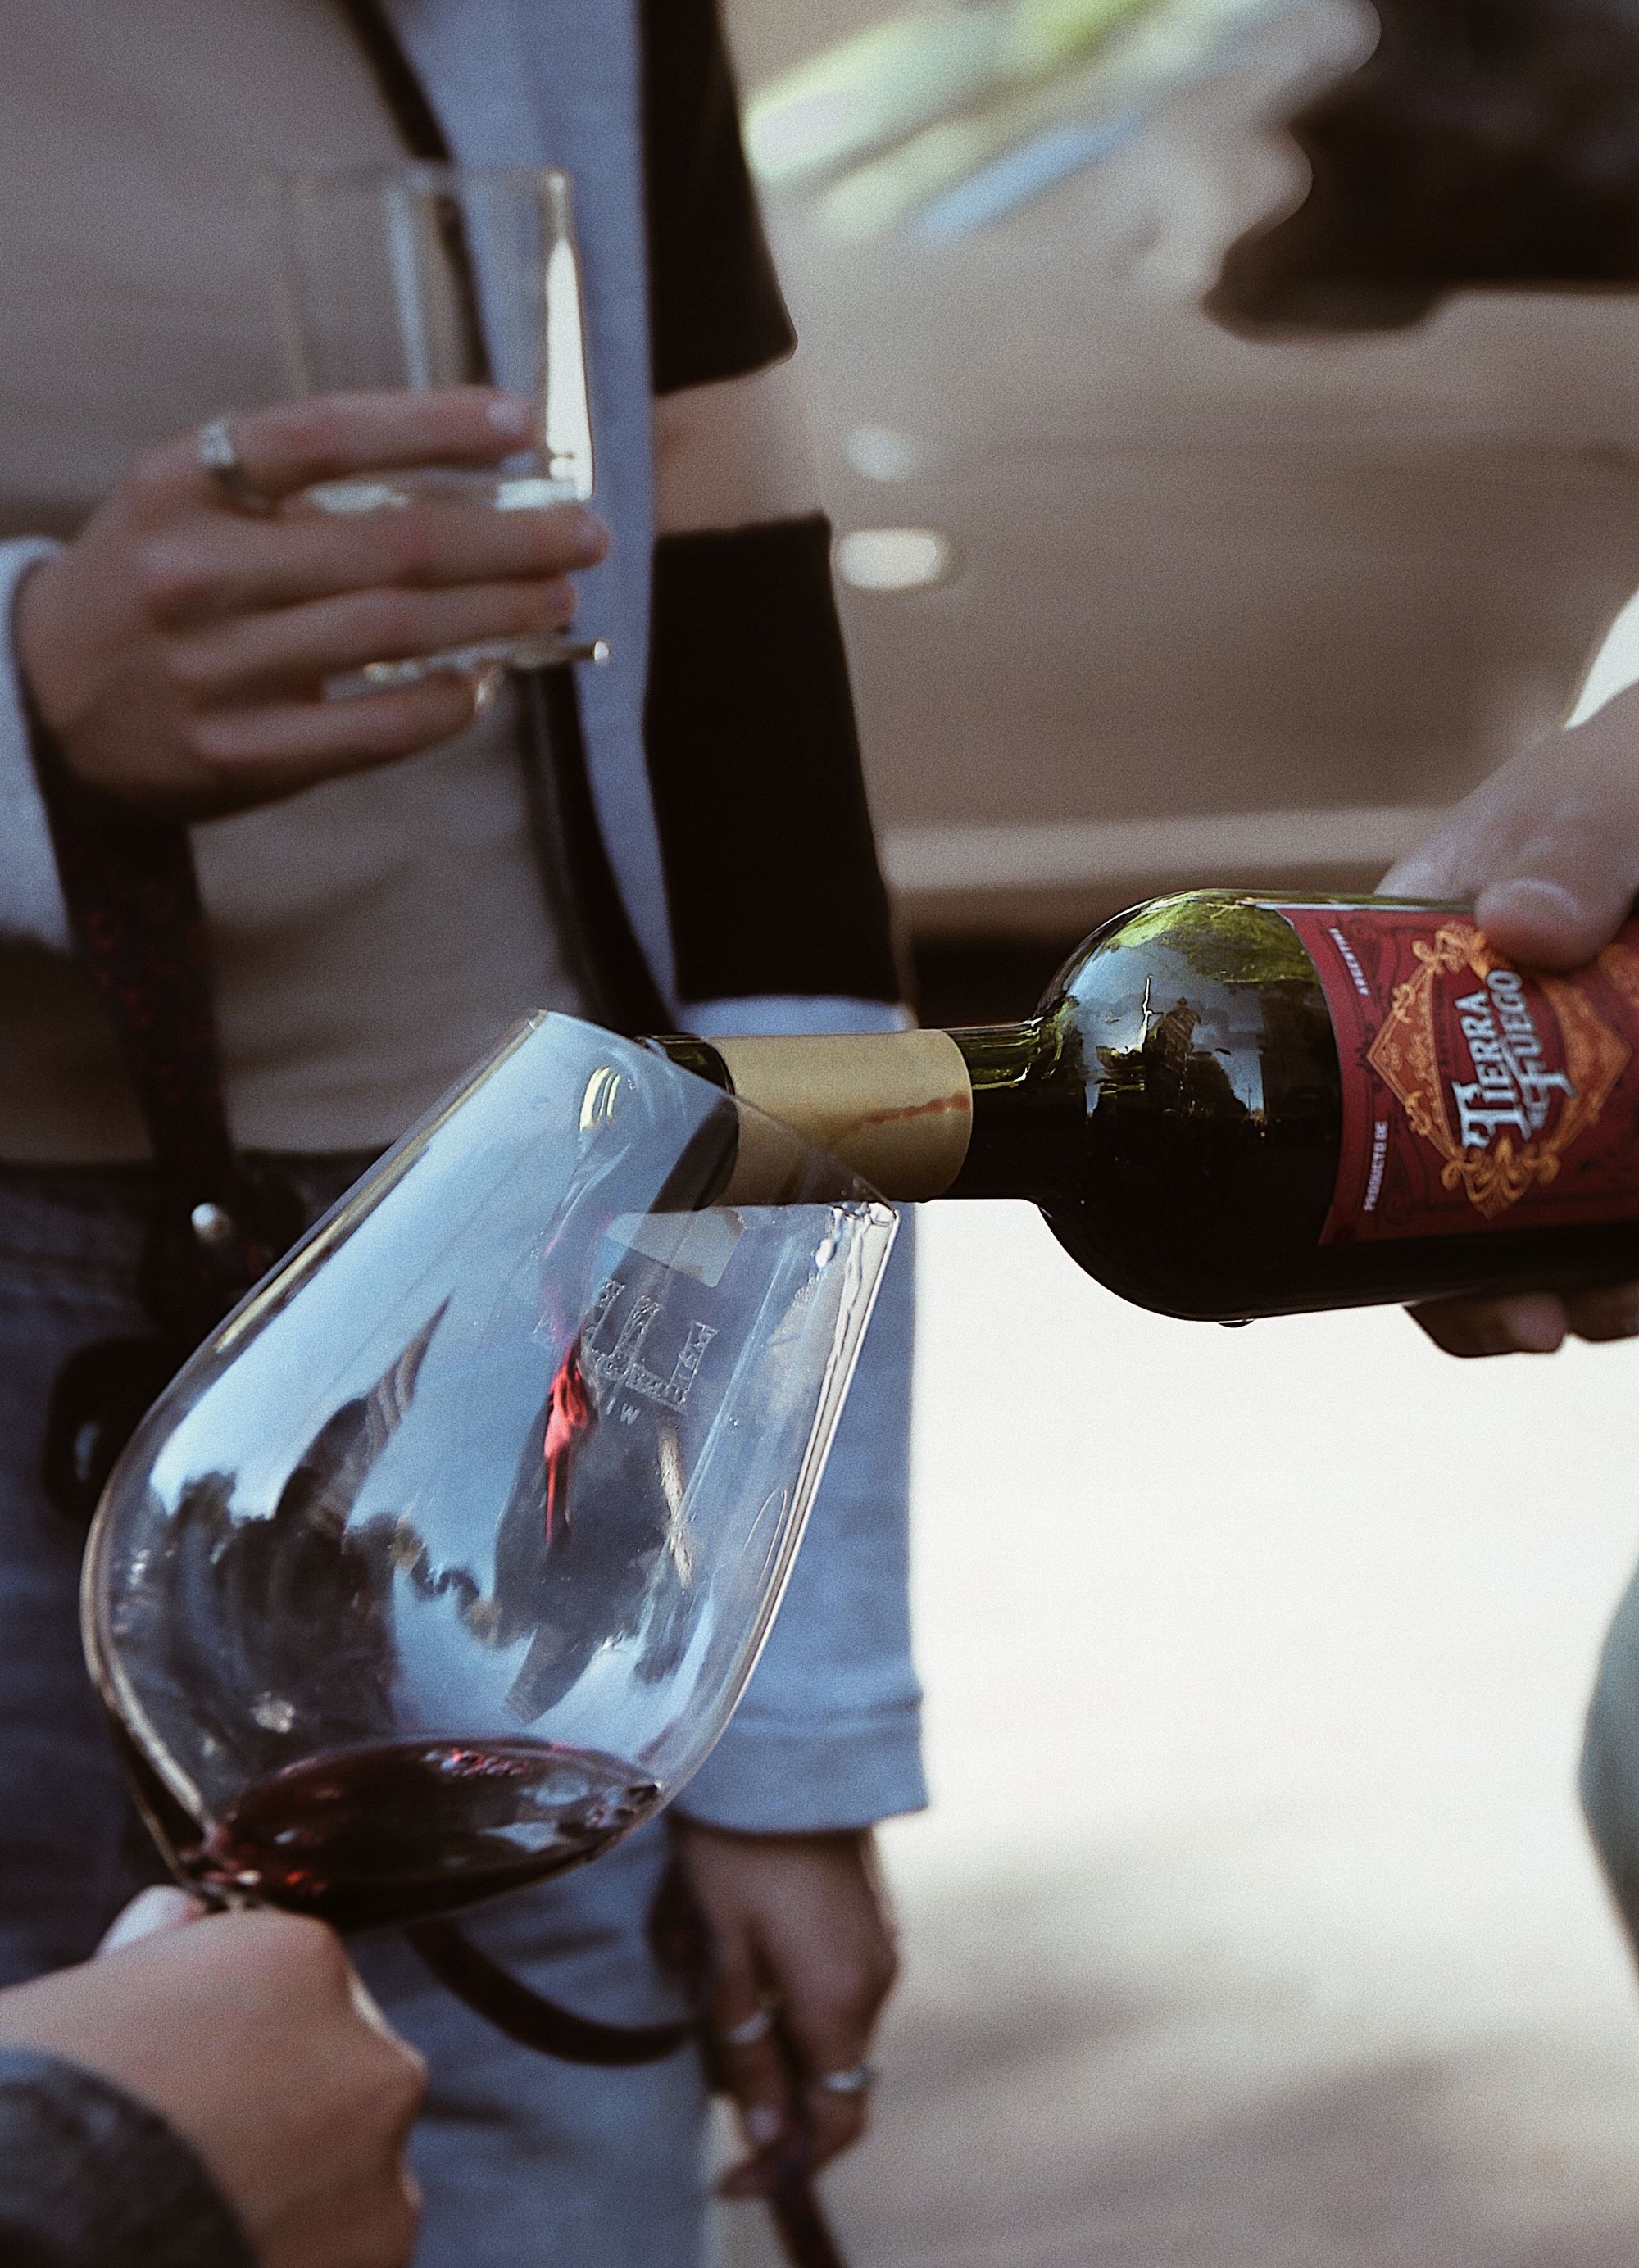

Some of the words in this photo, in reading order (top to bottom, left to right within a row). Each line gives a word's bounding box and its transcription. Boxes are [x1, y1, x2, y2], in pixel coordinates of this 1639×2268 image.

[1451, 988, 1532, 1148] TIERRA
[1486, 969, 1578, 1100] FUEGO
[1363, 1141, 1387, 1211] PRODUCTO
